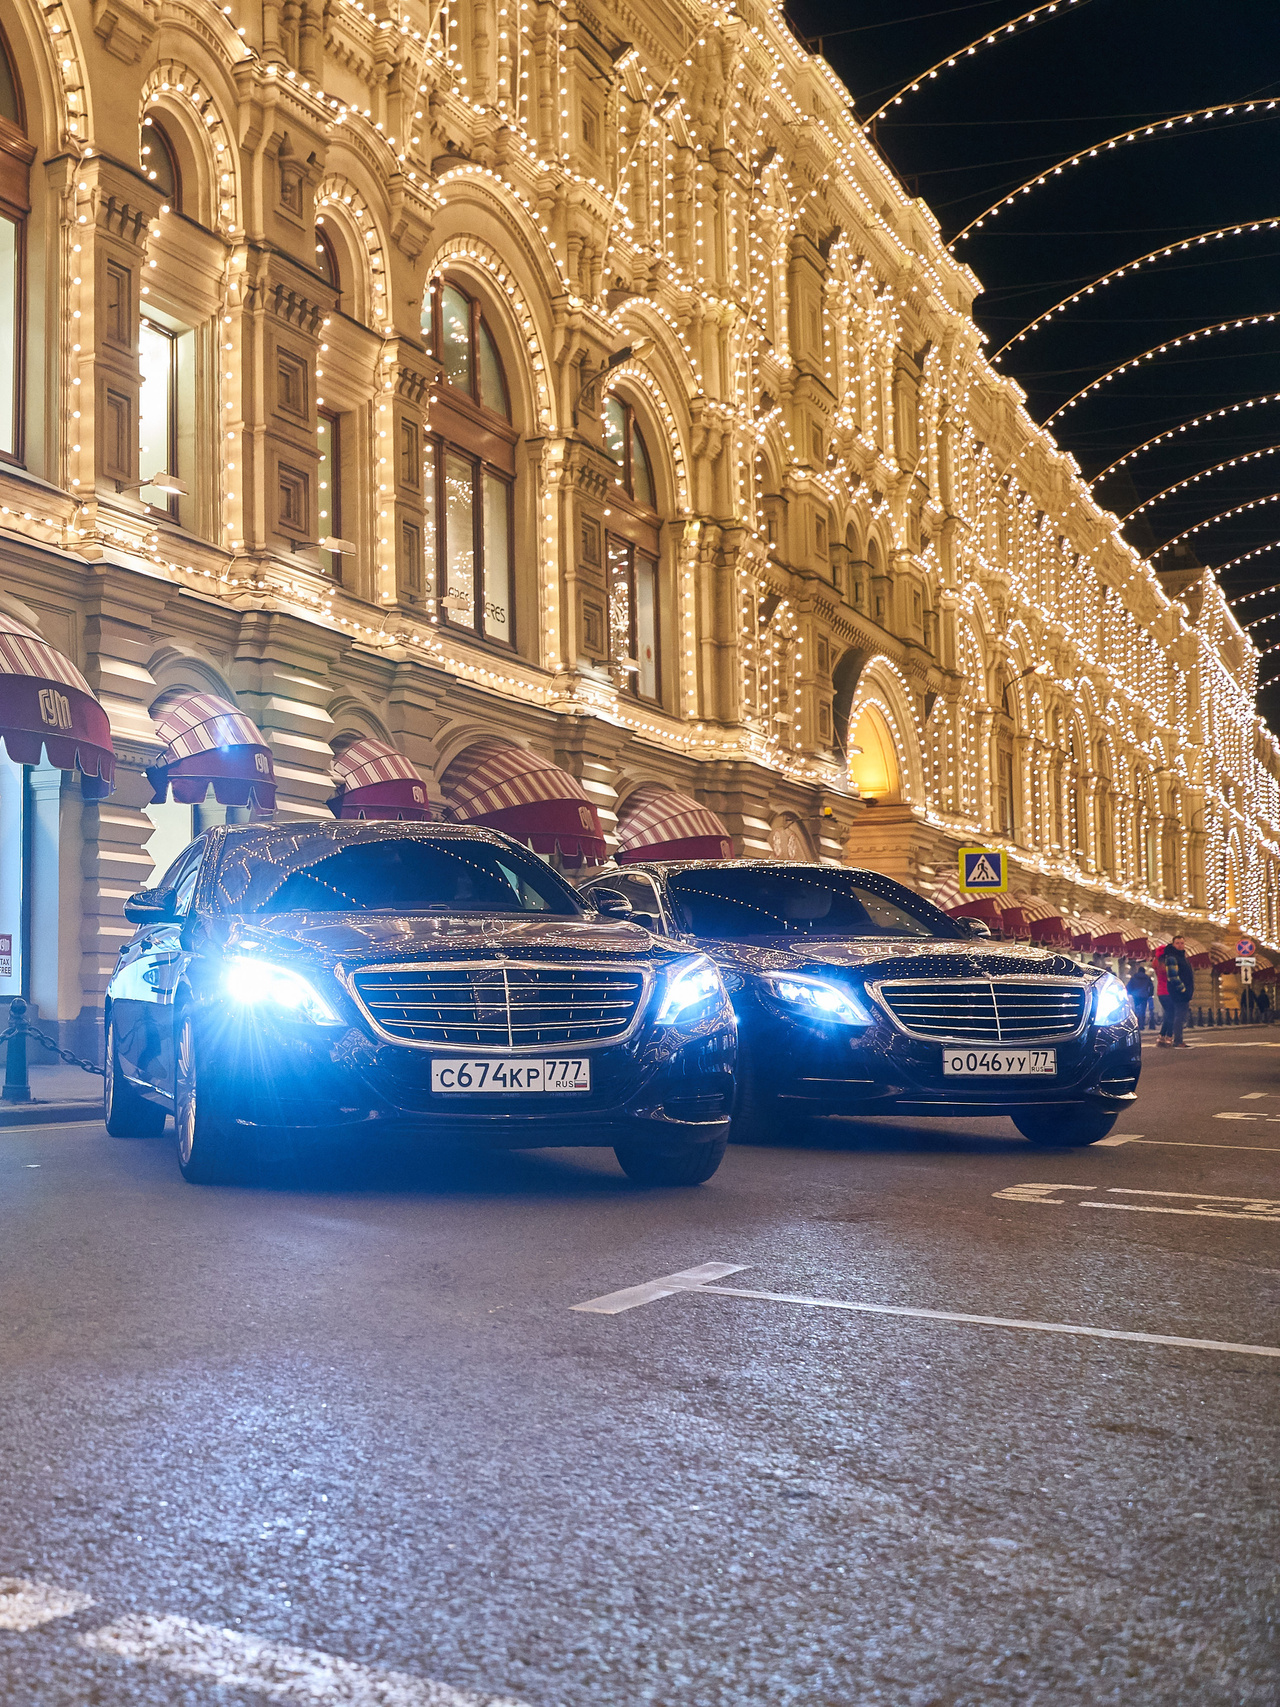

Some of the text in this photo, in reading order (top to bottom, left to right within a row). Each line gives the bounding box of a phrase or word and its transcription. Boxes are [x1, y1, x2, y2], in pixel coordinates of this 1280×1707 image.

[0, 958, 10, 966] TAX
[1031, 1052, 1048, 1066] 77
[545, 1061, 582, 1081] 777
[555, 1080, 574, 1088] RUS
